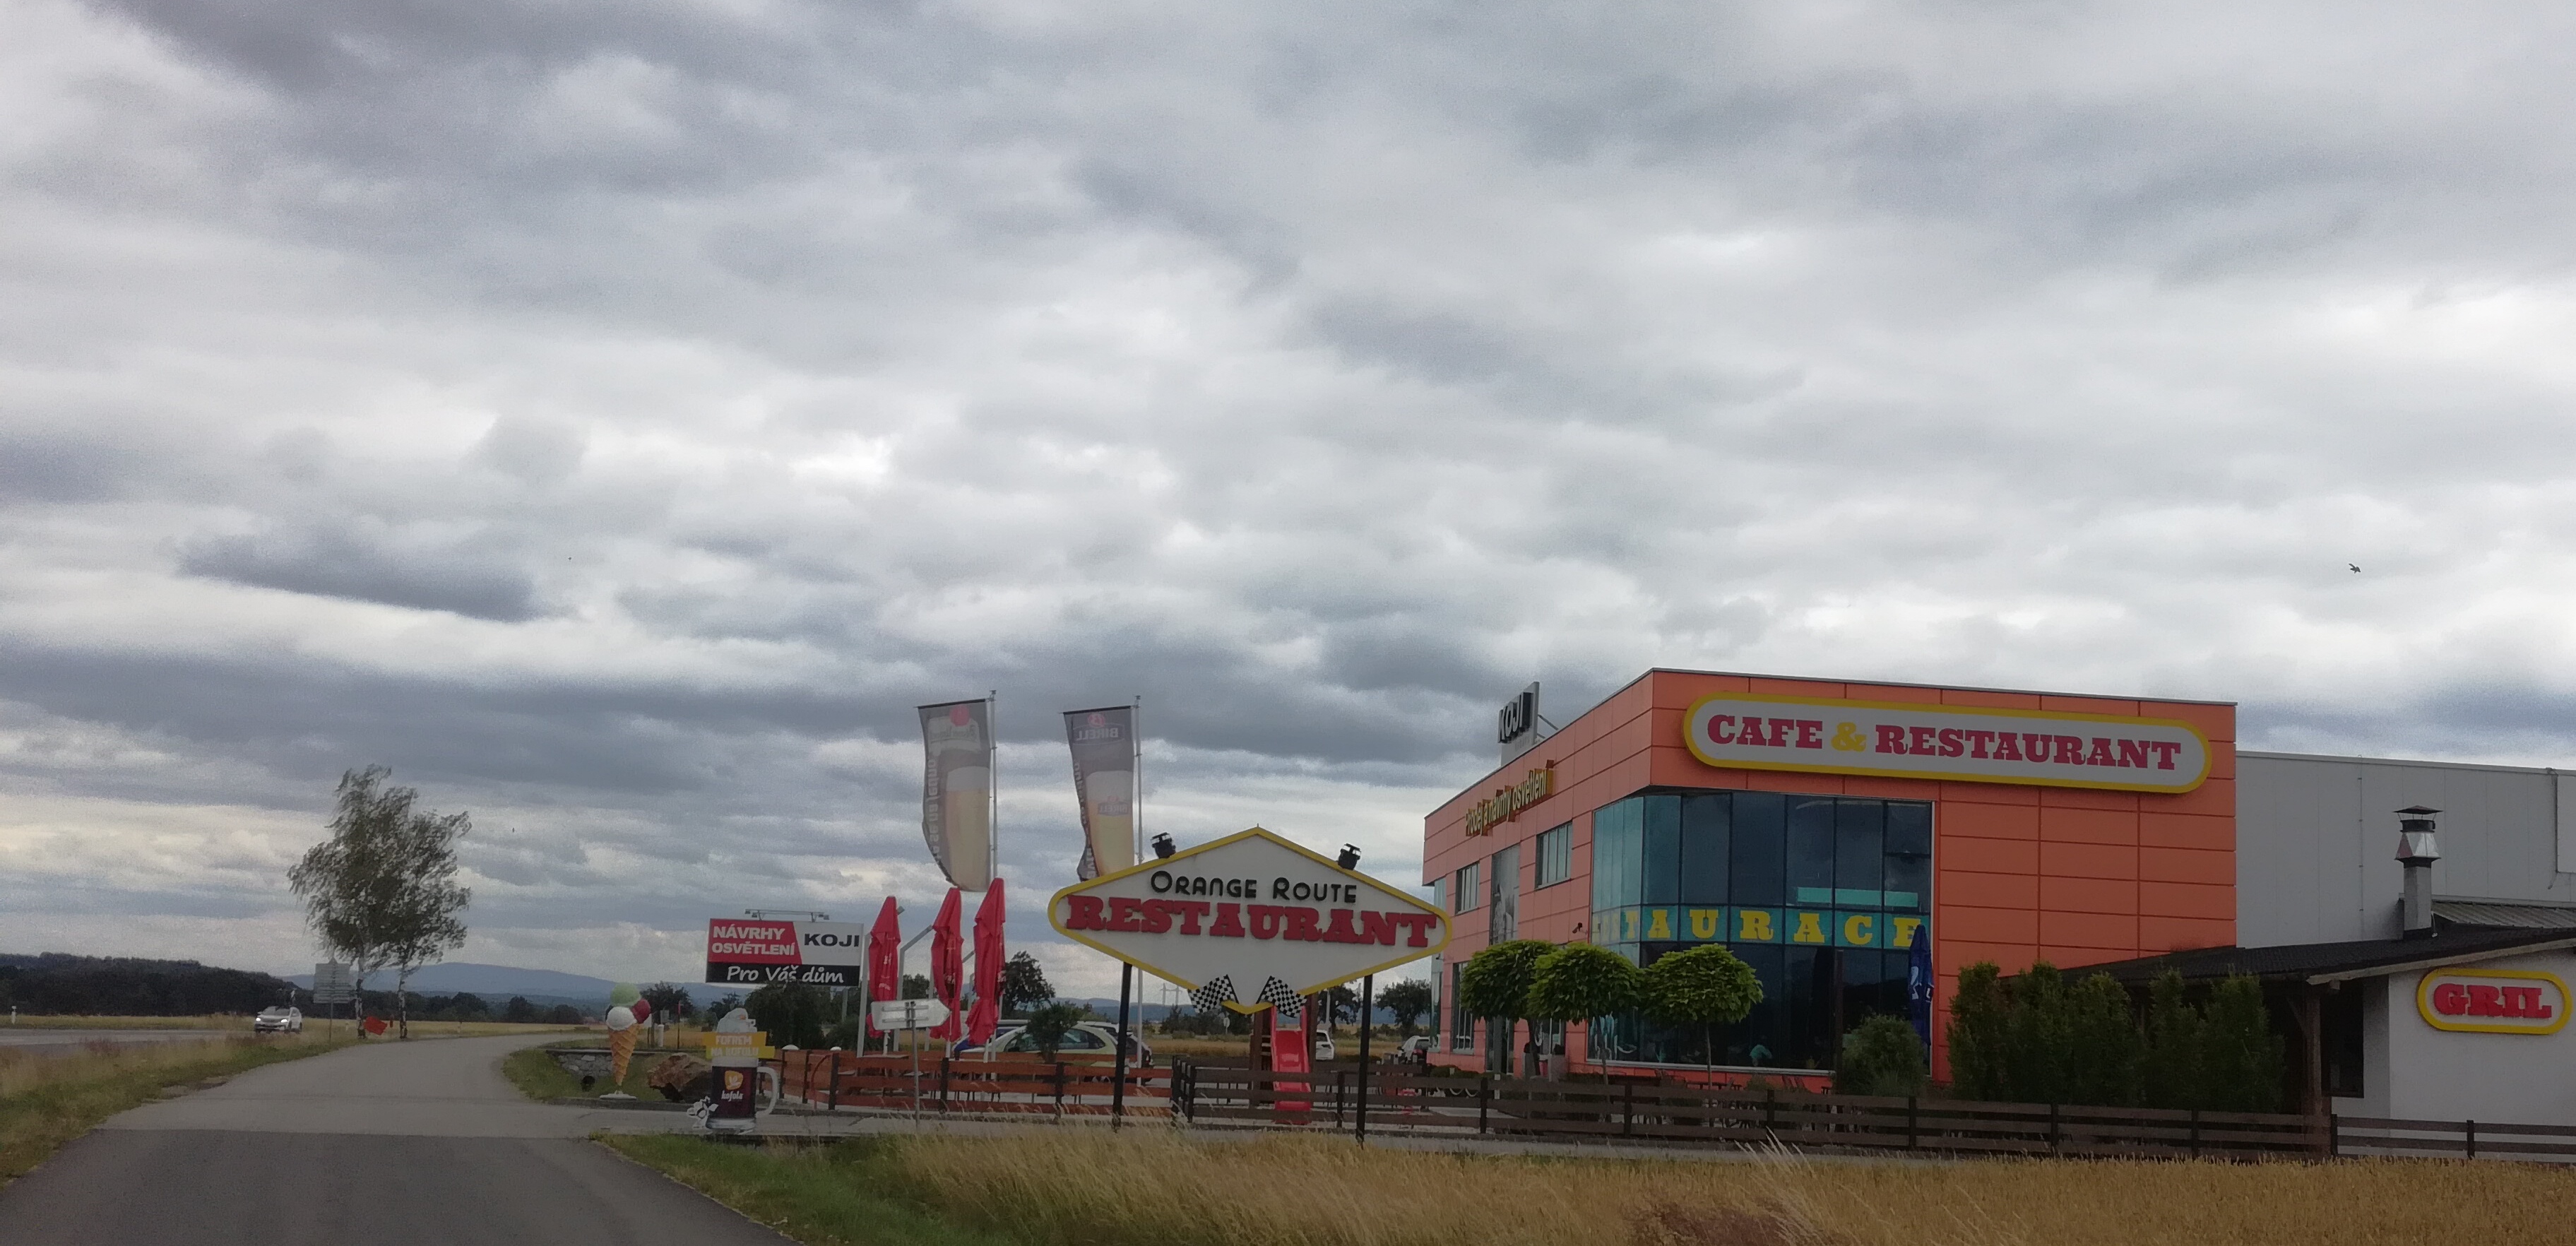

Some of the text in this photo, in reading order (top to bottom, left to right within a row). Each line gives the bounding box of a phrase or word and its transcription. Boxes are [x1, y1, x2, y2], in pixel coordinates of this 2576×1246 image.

[1497, 692, 1532, 743] KOJI
[1707, 714, 2181, 771] CAFE & RESTAURANT
[1066, 894, 1437, 948] RESTAURANT
[713, 923, 785, 939] NÁVRHY
[804, 932, 860, 947] KOJI
[711, 941, 795, 956] OSVĚTLENÍ
[727, 965, 845, 984] Pro Váš dům
[2433, 983, 2552, 1019] GRIL
[720, 1090, 744, 1102] kofola
